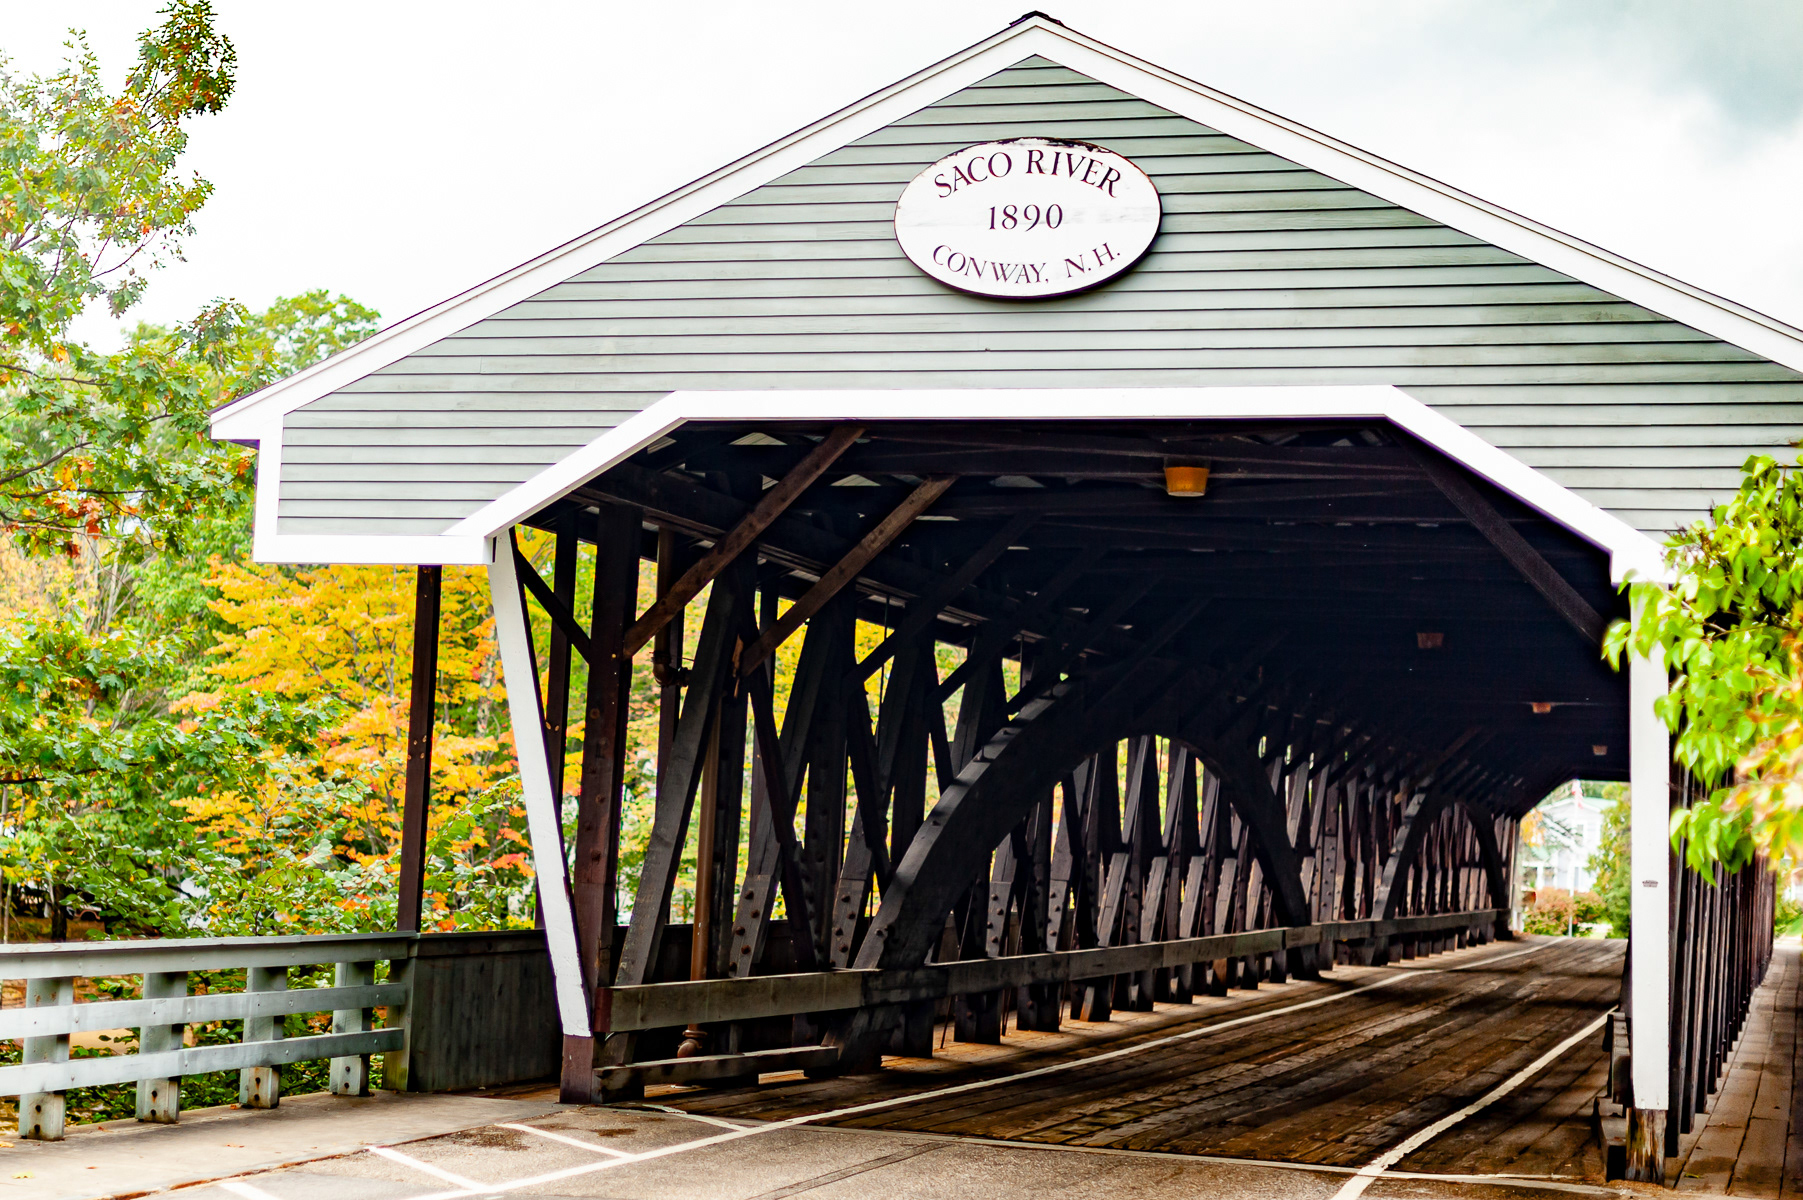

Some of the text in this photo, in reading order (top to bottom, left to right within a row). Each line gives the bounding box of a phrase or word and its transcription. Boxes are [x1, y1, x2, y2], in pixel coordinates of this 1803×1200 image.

[934, 150, 1121, 198] SACO RIVER
[989, 204, 1063, 232] 1890
[933, 242, 1121, 284] CONWAY, N.H.
